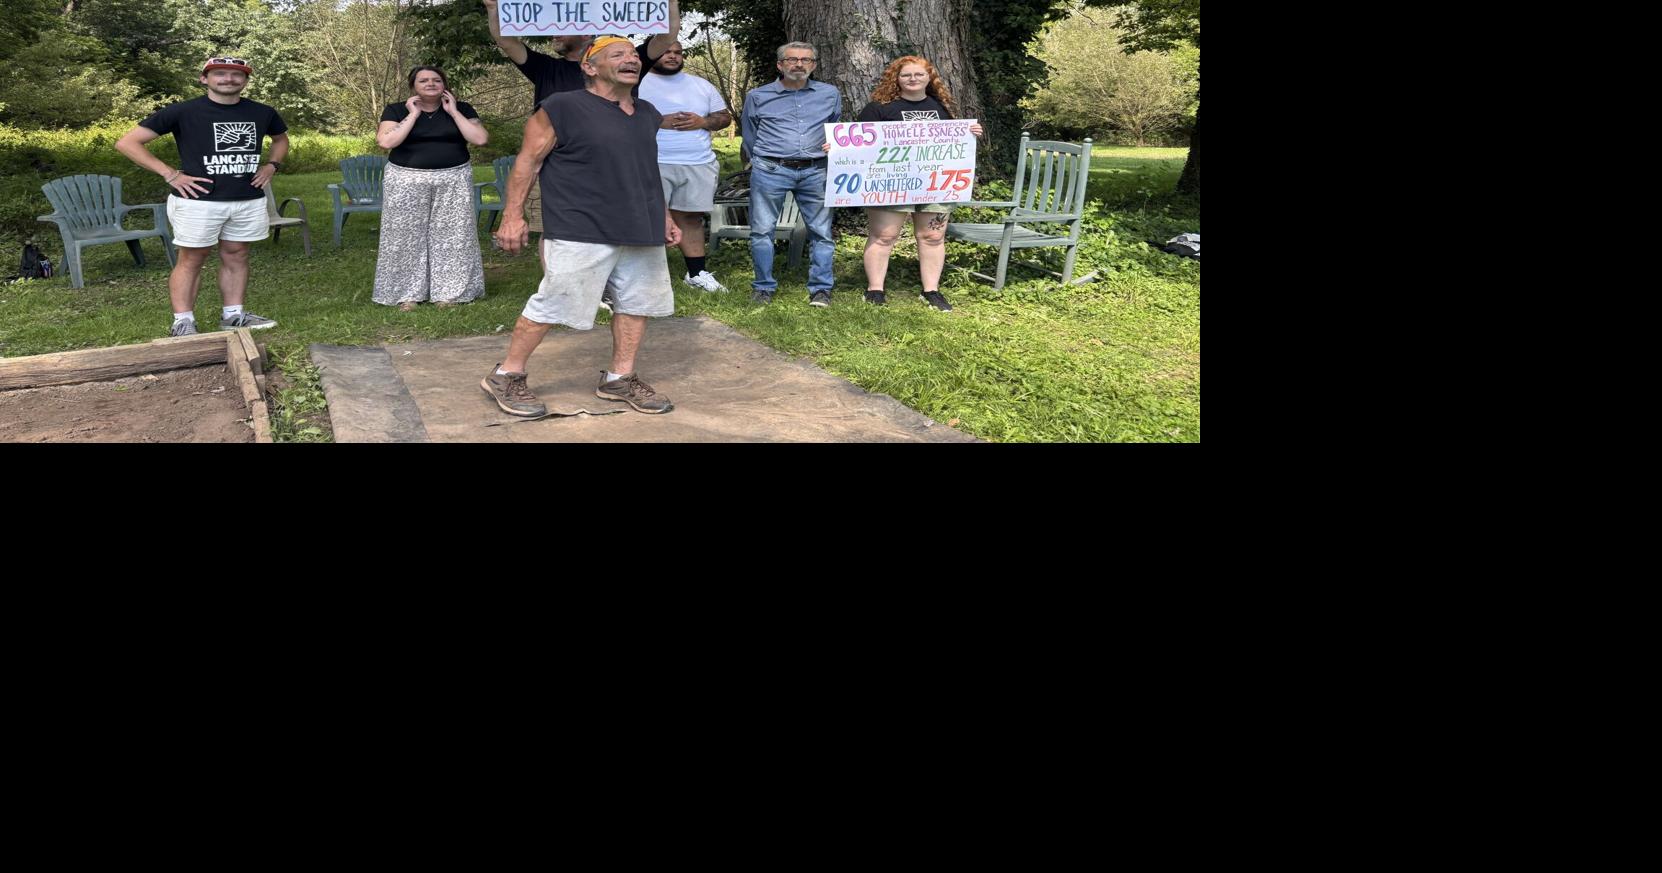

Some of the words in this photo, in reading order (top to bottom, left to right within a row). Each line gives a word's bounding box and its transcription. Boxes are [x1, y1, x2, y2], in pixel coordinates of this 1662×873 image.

[502, 2, 543, 23] STOP
[552, 2, 590, 22] THE
[602, 1, 668, 22] SWEEPS
[882, 122, 907, 131] people
[928, 121, 969, 129] experiencing
[884, 127, 966, 138] HOMELESSNESS
[833, 123, 877, 147] 665
[834, 157, 851, 165] which
[876, 146, 912, 164] 22%
[915, 143, 968, 161] INCREASE
[868, 163, 885, 173] from
[894, 162, 910, 172] last
[887, 171, 908, 179] living
[834, 173, 862, 194] 90
[927, 169, 972, 191] 175
[861, 191, 907, 204] YOUTH
[912, 192, 937, 202] under
